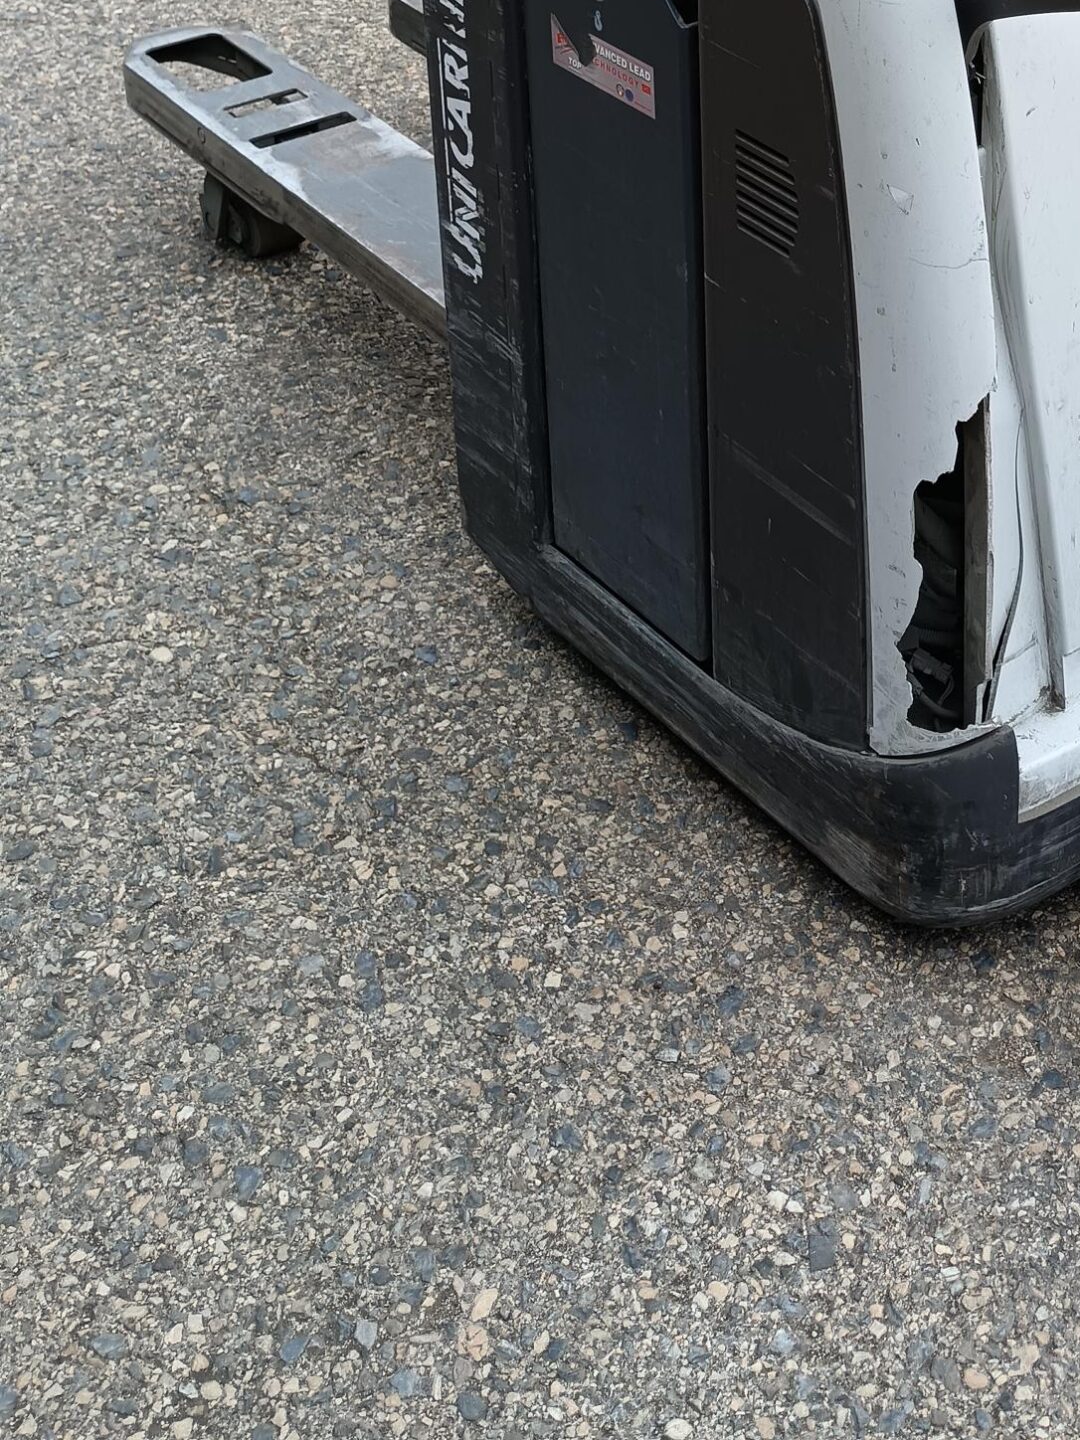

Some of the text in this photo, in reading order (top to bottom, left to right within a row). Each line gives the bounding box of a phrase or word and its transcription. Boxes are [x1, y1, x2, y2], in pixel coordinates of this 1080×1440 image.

[568, 56, 582, 69] TOP
[592, 56, 639, 87] CHNOLOGY
[593, 42, 650, 81] VANCED LEAD
